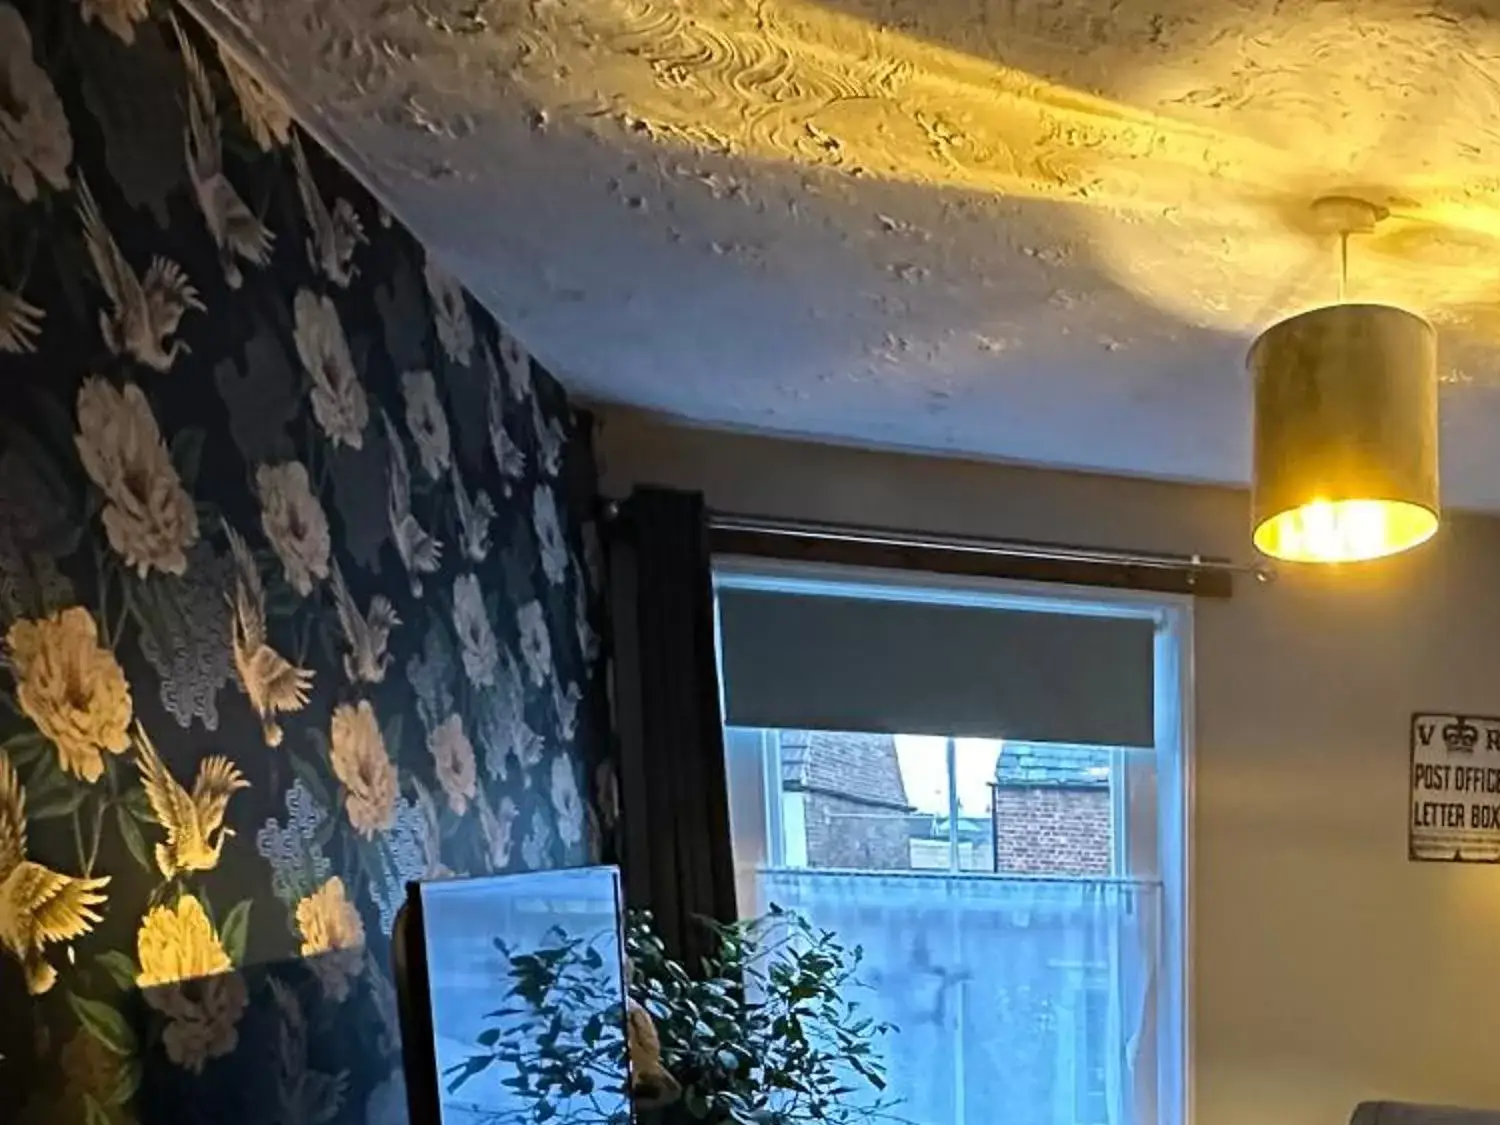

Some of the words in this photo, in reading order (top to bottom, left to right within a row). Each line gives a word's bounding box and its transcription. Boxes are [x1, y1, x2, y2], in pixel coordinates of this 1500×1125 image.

[1418, 724, 1435, 745] V
[1414, 763, 1451, 791] POST
[1414, 802, 1465, 827] LETTER
[1471, 805, 1500, 829] BOX
